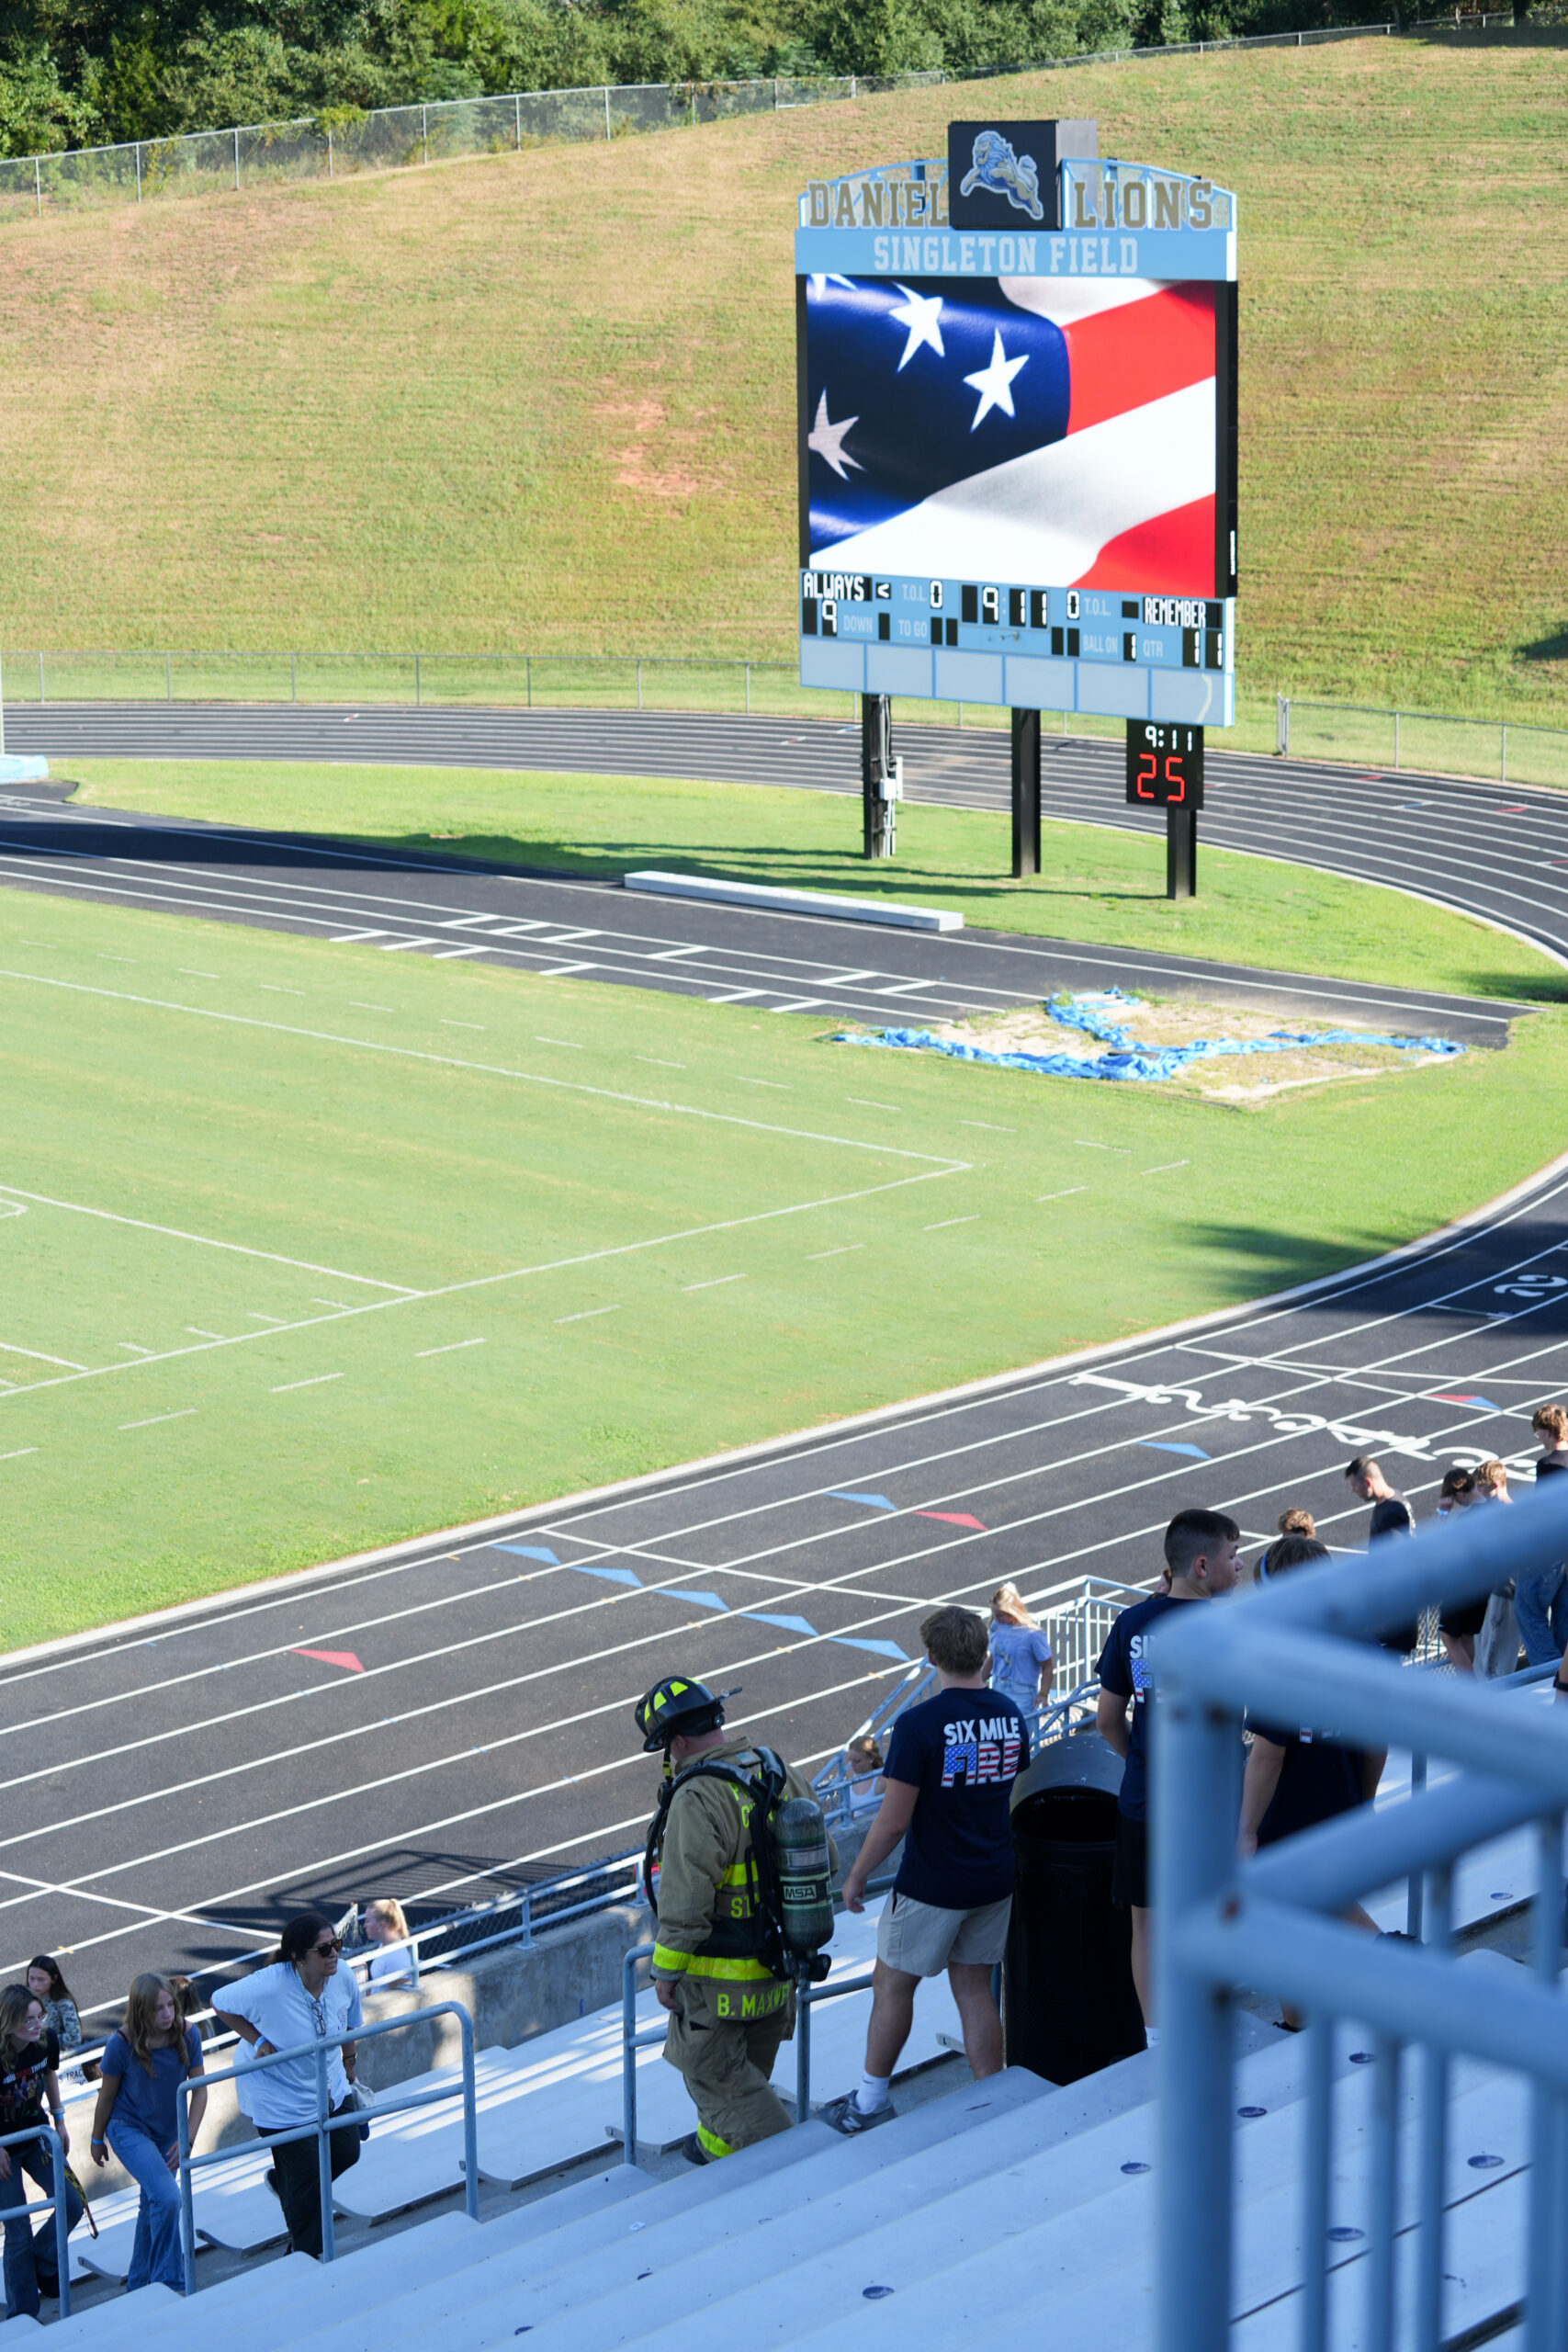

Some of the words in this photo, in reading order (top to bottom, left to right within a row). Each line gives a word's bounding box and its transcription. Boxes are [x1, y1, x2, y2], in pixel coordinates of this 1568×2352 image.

[807, 180, 949, 230] DANIEL
[1074, 179, 1213, 231] LIONS
[874, 236, 1036, 273] SINGLETON
[1050, 237, 1138, 274] FIELD
[803, 571, 864, 602] ALWAYS
[902, 583, 928, 603] T.O.L.
[930, 580, 943, 609] 0
[822, 600, 838, 633] 9
[1066, 590, 1080, 619] 0
[1083, 597, 1111, 616] T.O.L.
[1145, 596, 1207, 628] REMEMBER
[843, 615, 874, 633] DOWN
[898, 619, 912, 636] TO
[914, 620, 928, 638] GO
[1083, 633, 1104, 652] BALL
[1105, 636, 1118, 654] ON
[1143, 639, 1164, 658] QTR
[1145, 725, 1192, 752] 9:11
[1136, 752, 1185, 802] 25
[943, 1720, 976, 1746] SIX
[979, 1716, 1021, 1742] MILE
[941, 1738, 1023, 1788] FIRE
[784, 1887, 816, 1899] MSA
[716, 1993, 735, 2017] B.
[65, 2068, 84, 2081] TRAC
